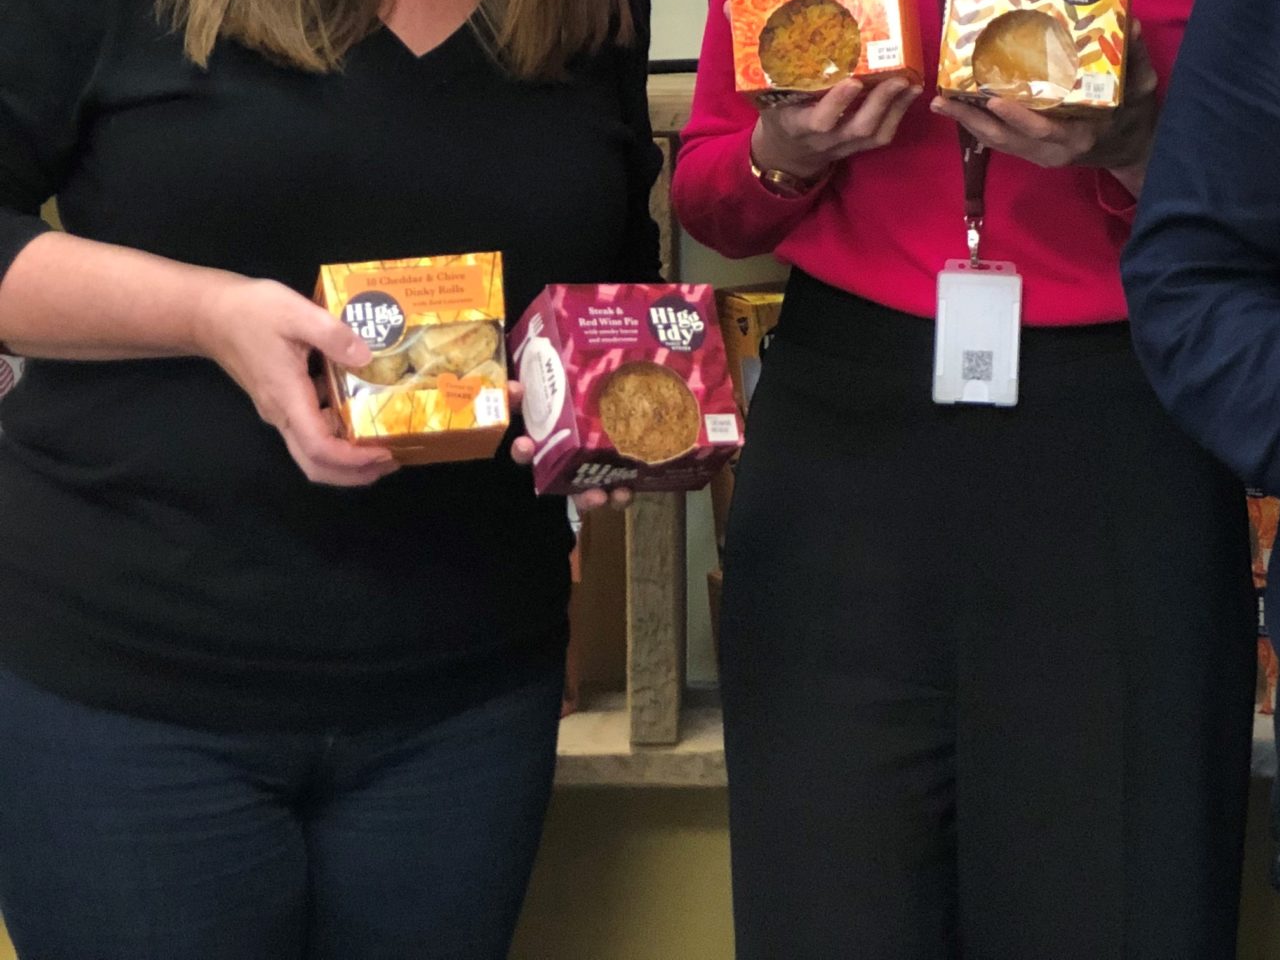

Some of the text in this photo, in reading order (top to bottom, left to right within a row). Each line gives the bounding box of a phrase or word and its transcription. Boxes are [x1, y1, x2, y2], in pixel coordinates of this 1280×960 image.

[379, 275, 424, 286] Cheddar
[426, 273, 434, 282] &
[436, 272, 466, 282] Chive
[404, 286, 464, 300] Dinky Rolls
[346, 302, 404, 326] Higg
[588, 306, 624, 316] Steak &
[650, 307, 704, 332] Higg
[352, 322, 391, 342] idy
[578, 318, 639, 327] Red Wine Pie
[657, 326, 694, 346] idy
[544, 358, 558, 396] WIN
